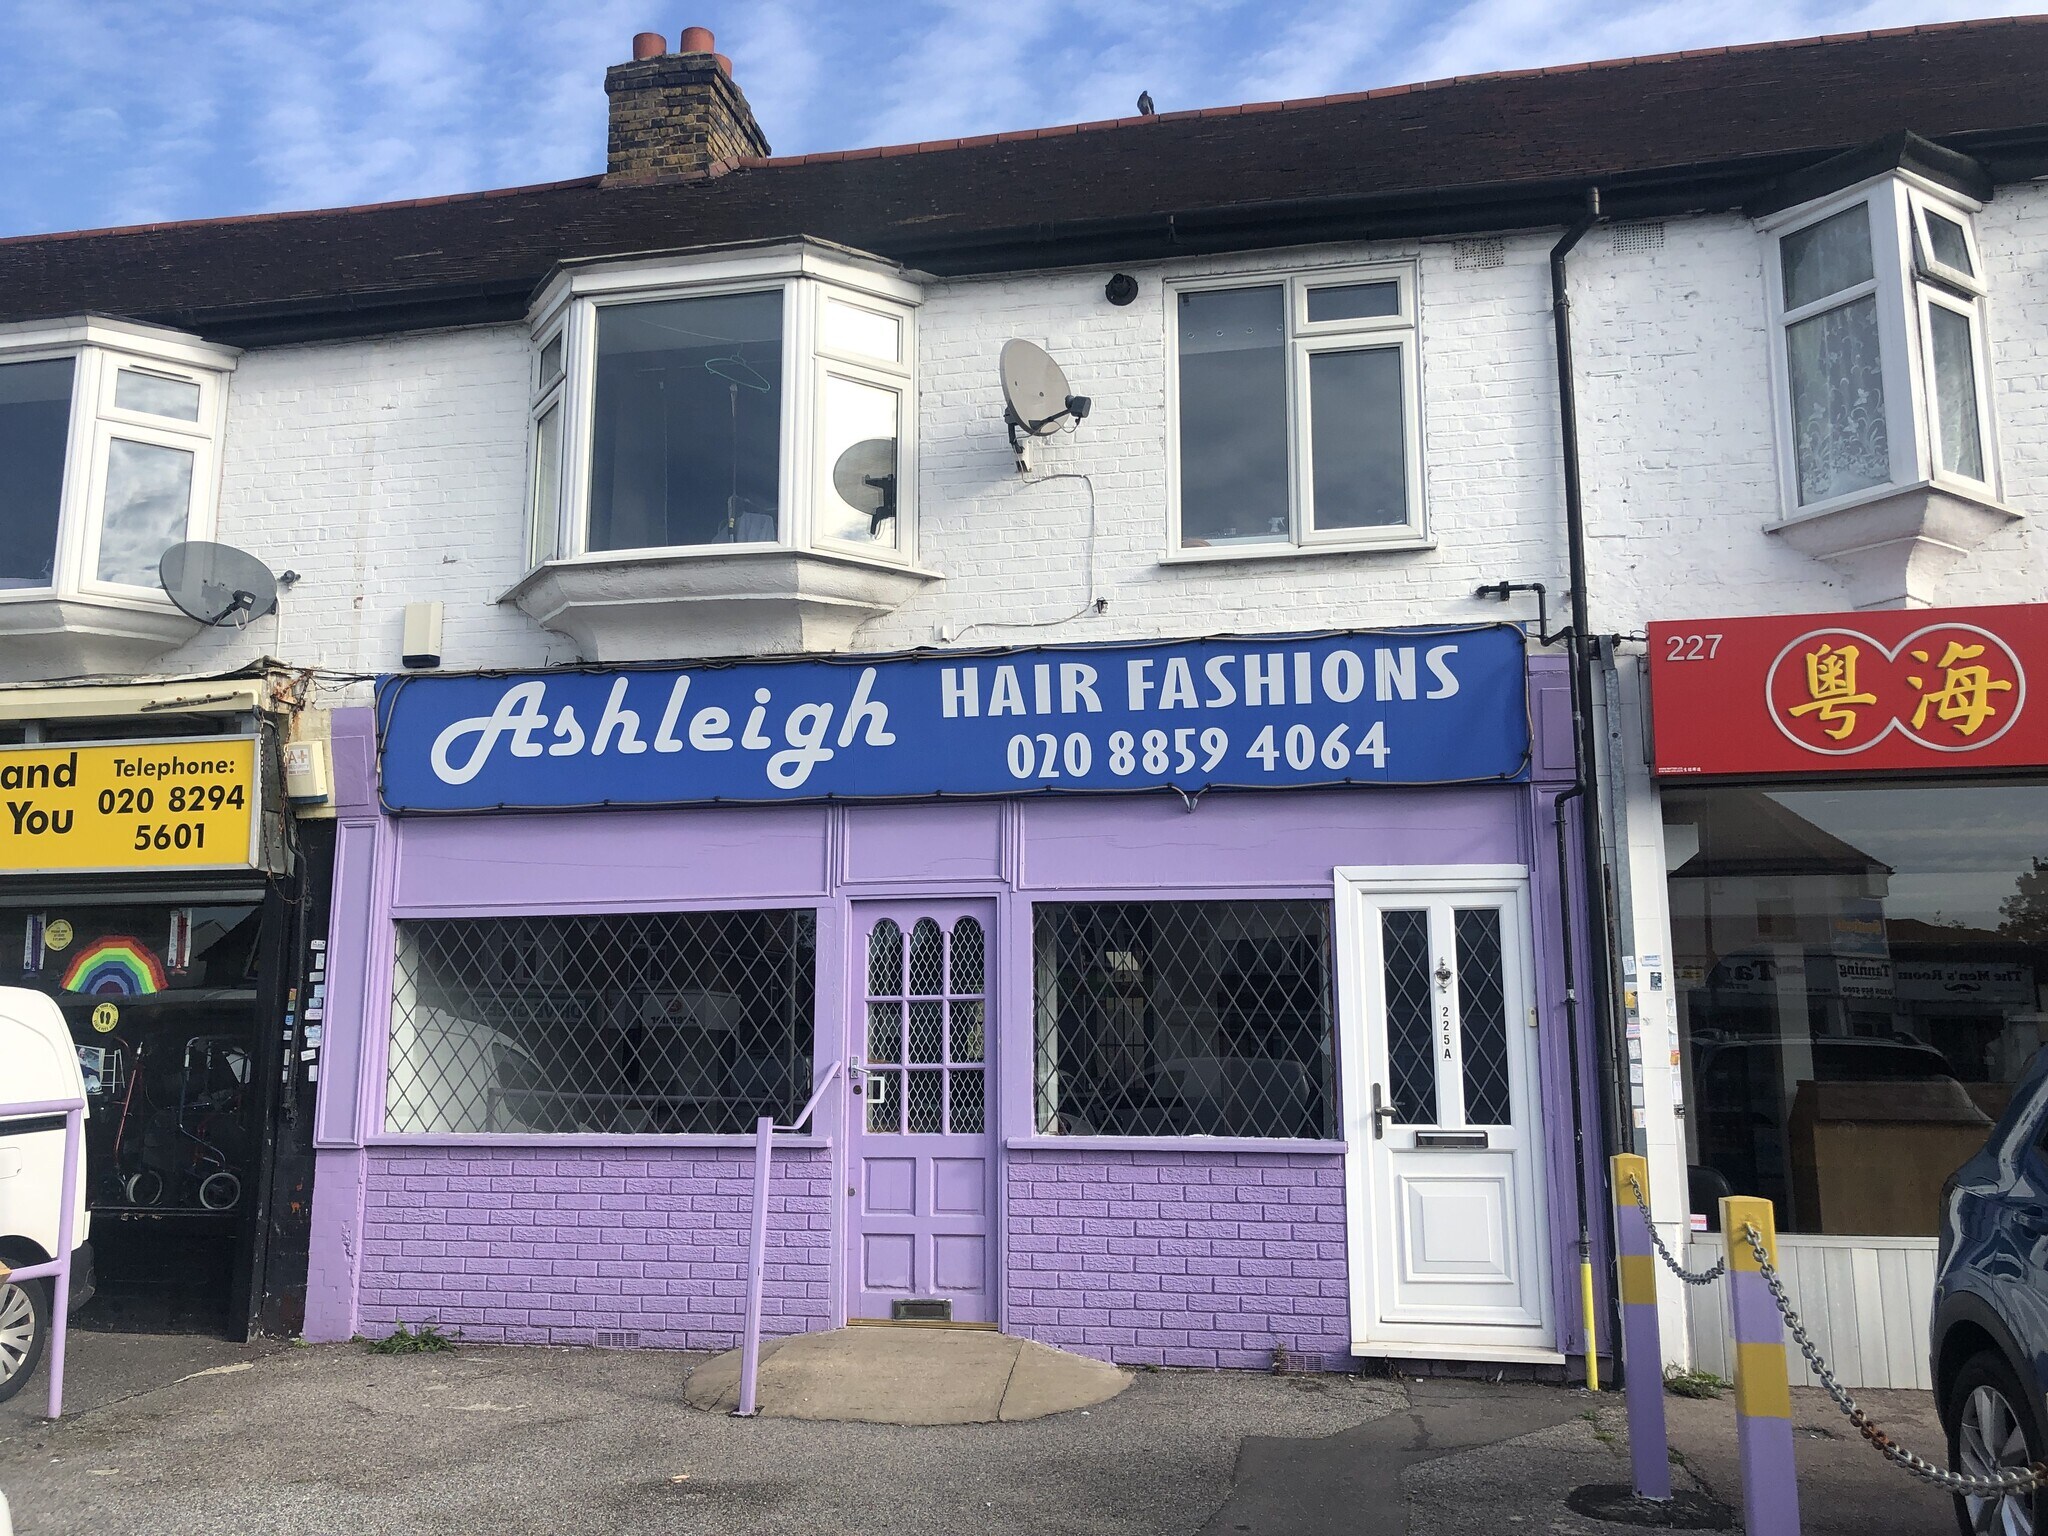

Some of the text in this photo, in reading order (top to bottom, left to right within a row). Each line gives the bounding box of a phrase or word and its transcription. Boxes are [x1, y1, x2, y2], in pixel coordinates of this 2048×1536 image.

[1666, 634, 1723, 661] 227
[940, 644, 1460, 718] HAIR FASHIONS
[430, 667, 896, 790] Ashleigh
[113, 755, 235, 781] Telephone:
[1006, 720, 1391, 779] 020 8859 4064
[0, 751, 78, 789] and
[6, 800, 74, 836] You
[98, 784, 245, 815] 020 8294
[134, 823, 206, 850] 5601
[1442, 1006, 1452, 1059] 225A
